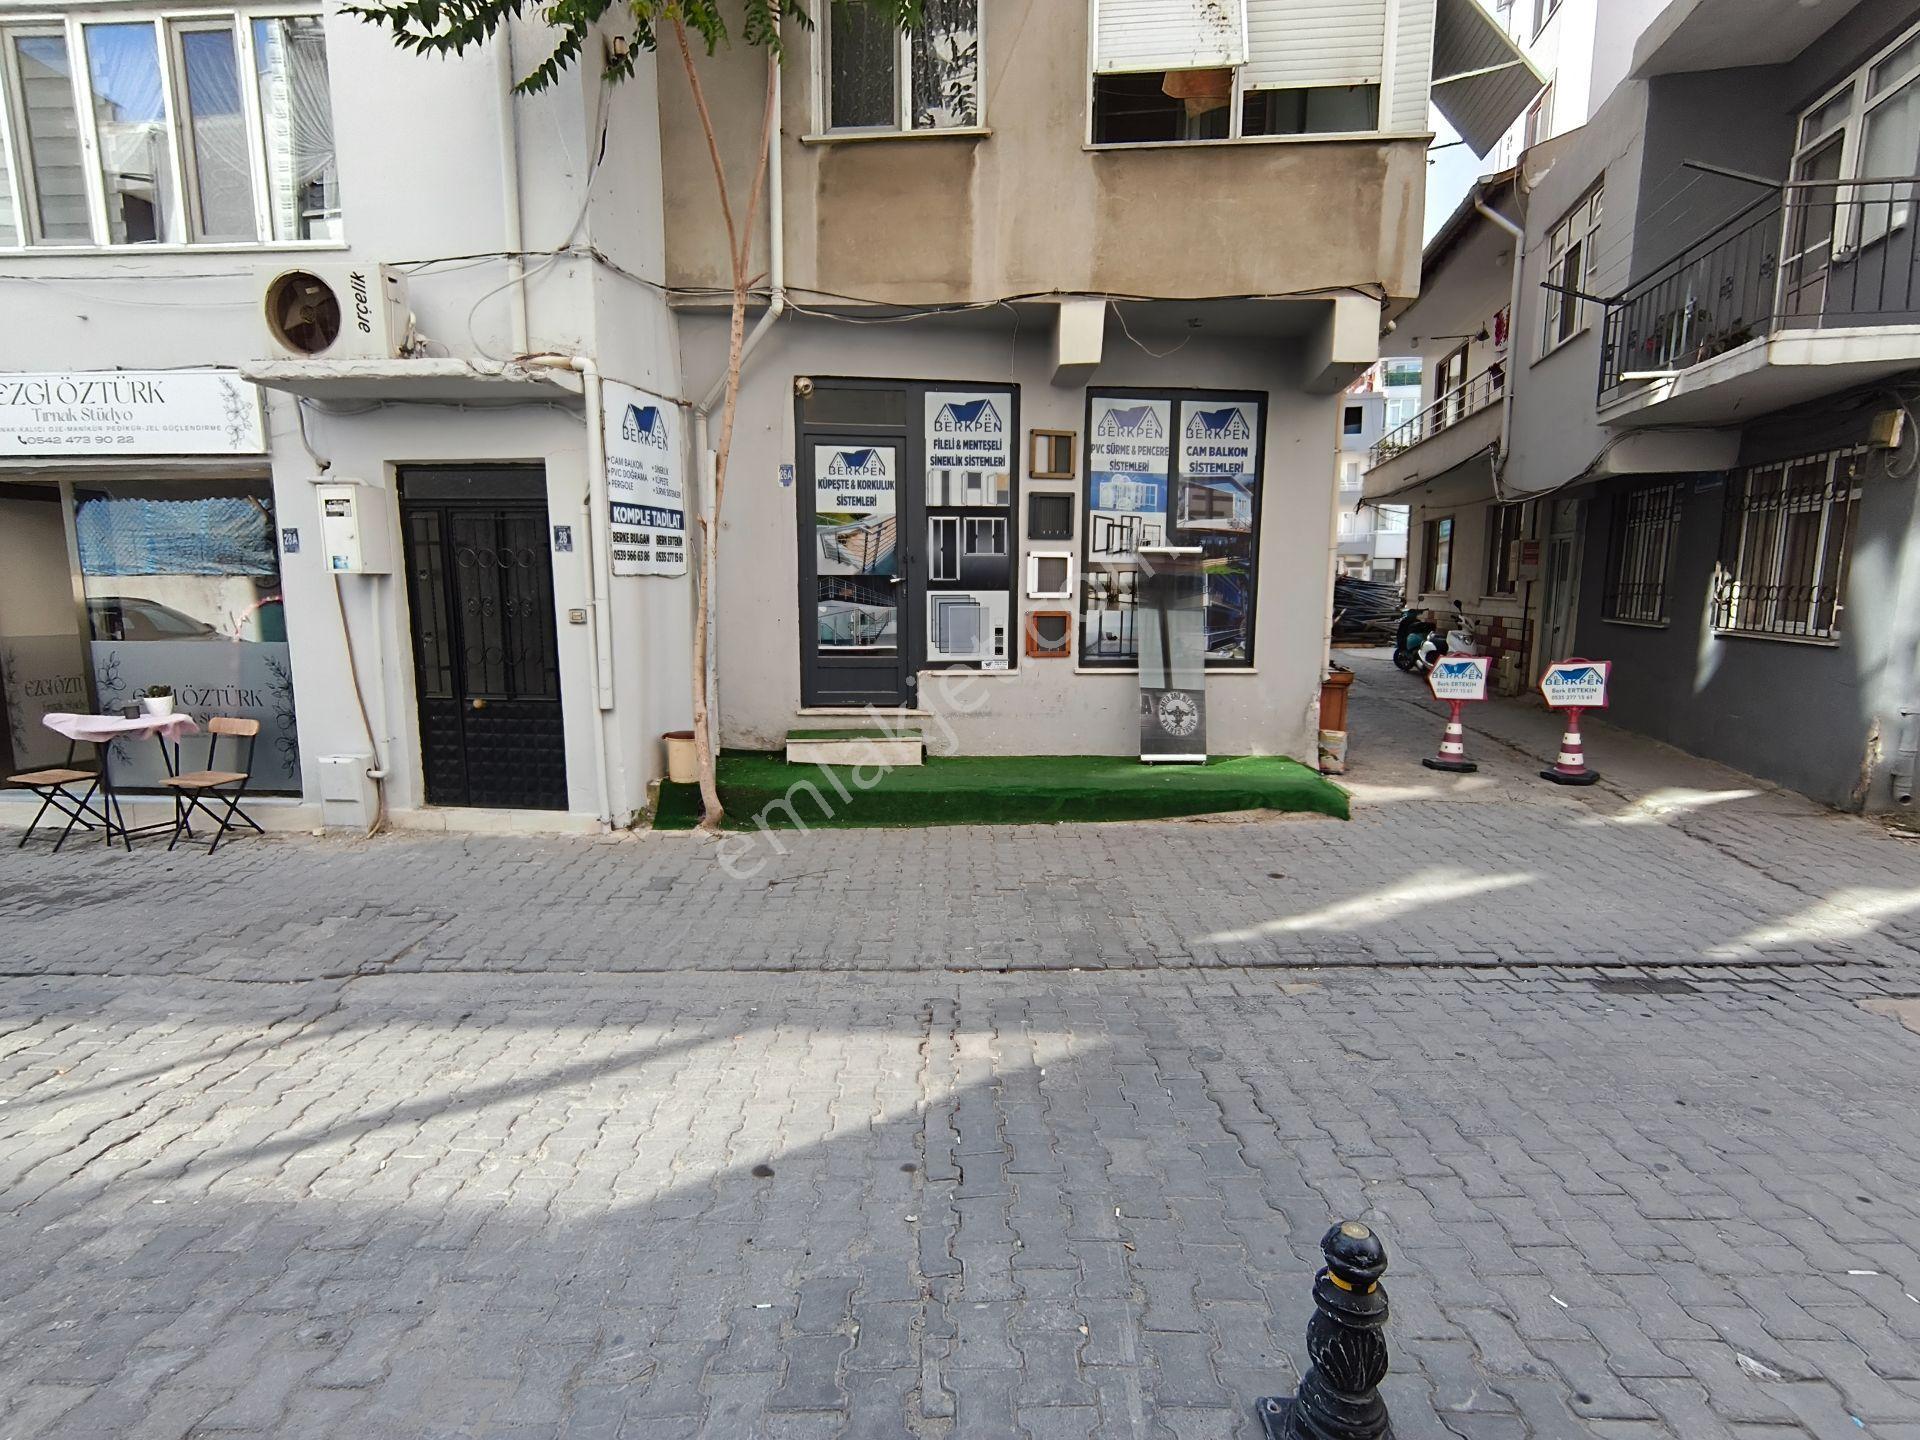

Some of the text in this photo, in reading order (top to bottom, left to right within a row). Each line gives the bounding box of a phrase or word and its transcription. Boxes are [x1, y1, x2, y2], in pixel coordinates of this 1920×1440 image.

[350, 271, 371, 333] arçelik
[57, 376, 165, 404] ÖZTÜRK
[31, 407, 133, 424] Tırnak Stüdyo
[934, 420, 1002, 433] BERKPEN
[1097, 426, 1162, 439] BERKPEN
[27, 435, 135, 444] 0542 473 90 22
[623, 425, 668, 451] BERKPEN
[1186, 427, 1249, 440] BERKPEN
[933, 437, 1002, 452] FİLELİ & MENTEŞELİ
[1091, 442, 1169, 457] PVC SÜRME & PENCERE
[1187, 446, 1248, 457] CAM BALKON
[611, 456, 643, 470] CAM BALKON
[930, 454, 1006, 467] SİNEKLİK SİSTEMLERİ
[1109, 459, 1149, 472] SİSTEMLERİ
[1189, 461, 1244, 473] SİSTEMLERİ
[611, 468, 648, 481] PVC DOĞRAMA
[828, 465, 886, 476] BERKPEN
[611, 480, 634, 490] PERGOLE
[818, 477, 895, 491] KÜPEŞTE & KORKULUK
[836, 494, 877, 506] SİSTEMLERİ
[613, 506, 681, 528] KOMPLE TADİLAT
[612, 531, 650, 545] BERKE BULGAN
[656, 535, 667, 545] BERK
[613, 549, 626, 561] 0539
[1432, 672, 1482, 680] BERKPEN
[182, 684, 263, 707] ÖZTÜRK
